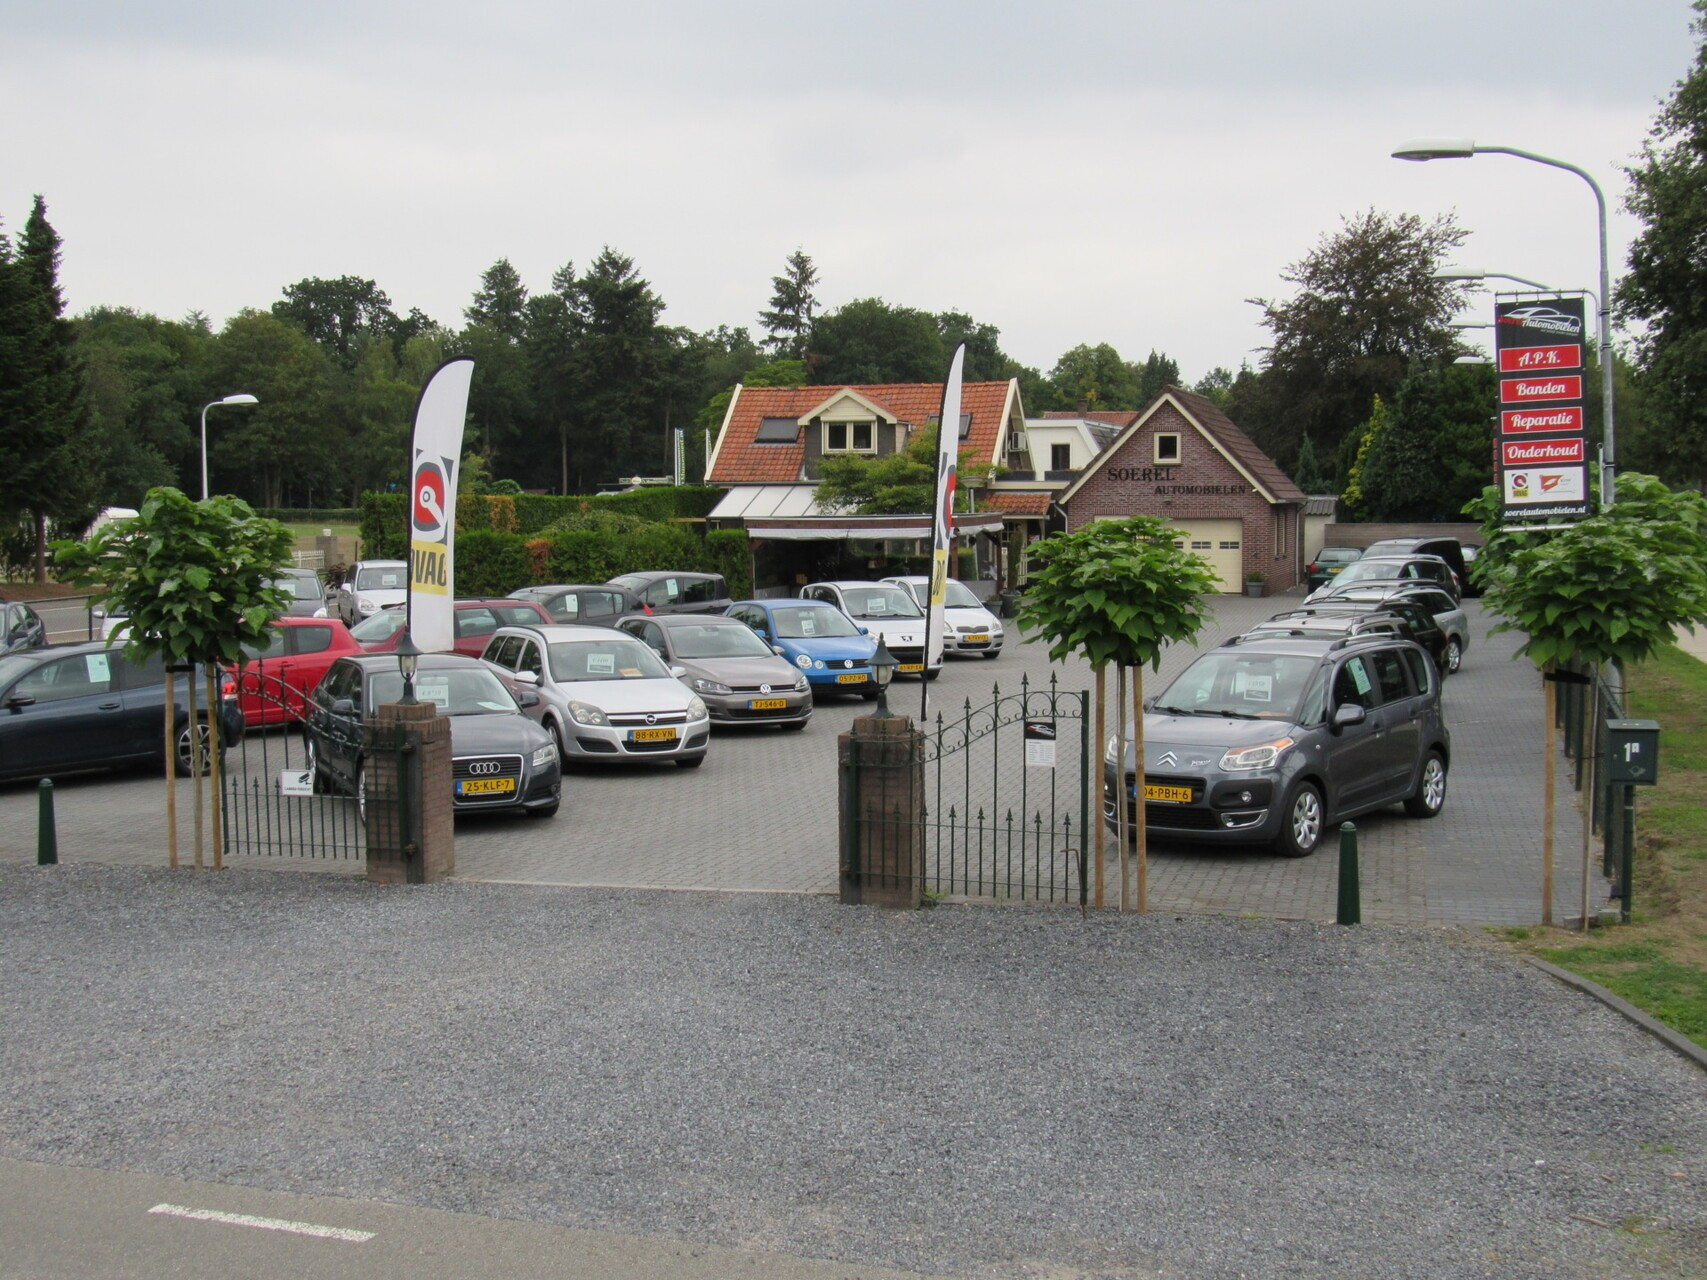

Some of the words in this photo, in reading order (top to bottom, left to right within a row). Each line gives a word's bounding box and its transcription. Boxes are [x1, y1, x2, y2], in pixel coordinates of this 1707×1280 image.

[1521, 317, 1580, 333] Automobielen
[1518, 350, 1560, 367] A.P.K.
[1516, 382, 1566, 396] Banden
[1511, 412, 1573, 430] Reparatie
[1507, 443, 1579, 459] Onderhoud
[1107, 467, 1175, 482] SOEREL
[1154, 485, 1246, 495] AUTOMOBIELEN
[1504, 505, 1586, 517] soerelautomobielen.nl
[635, 730, 673, 739] 88-RX-VN
[466, 780, 510, 792] 25-KLF-7
